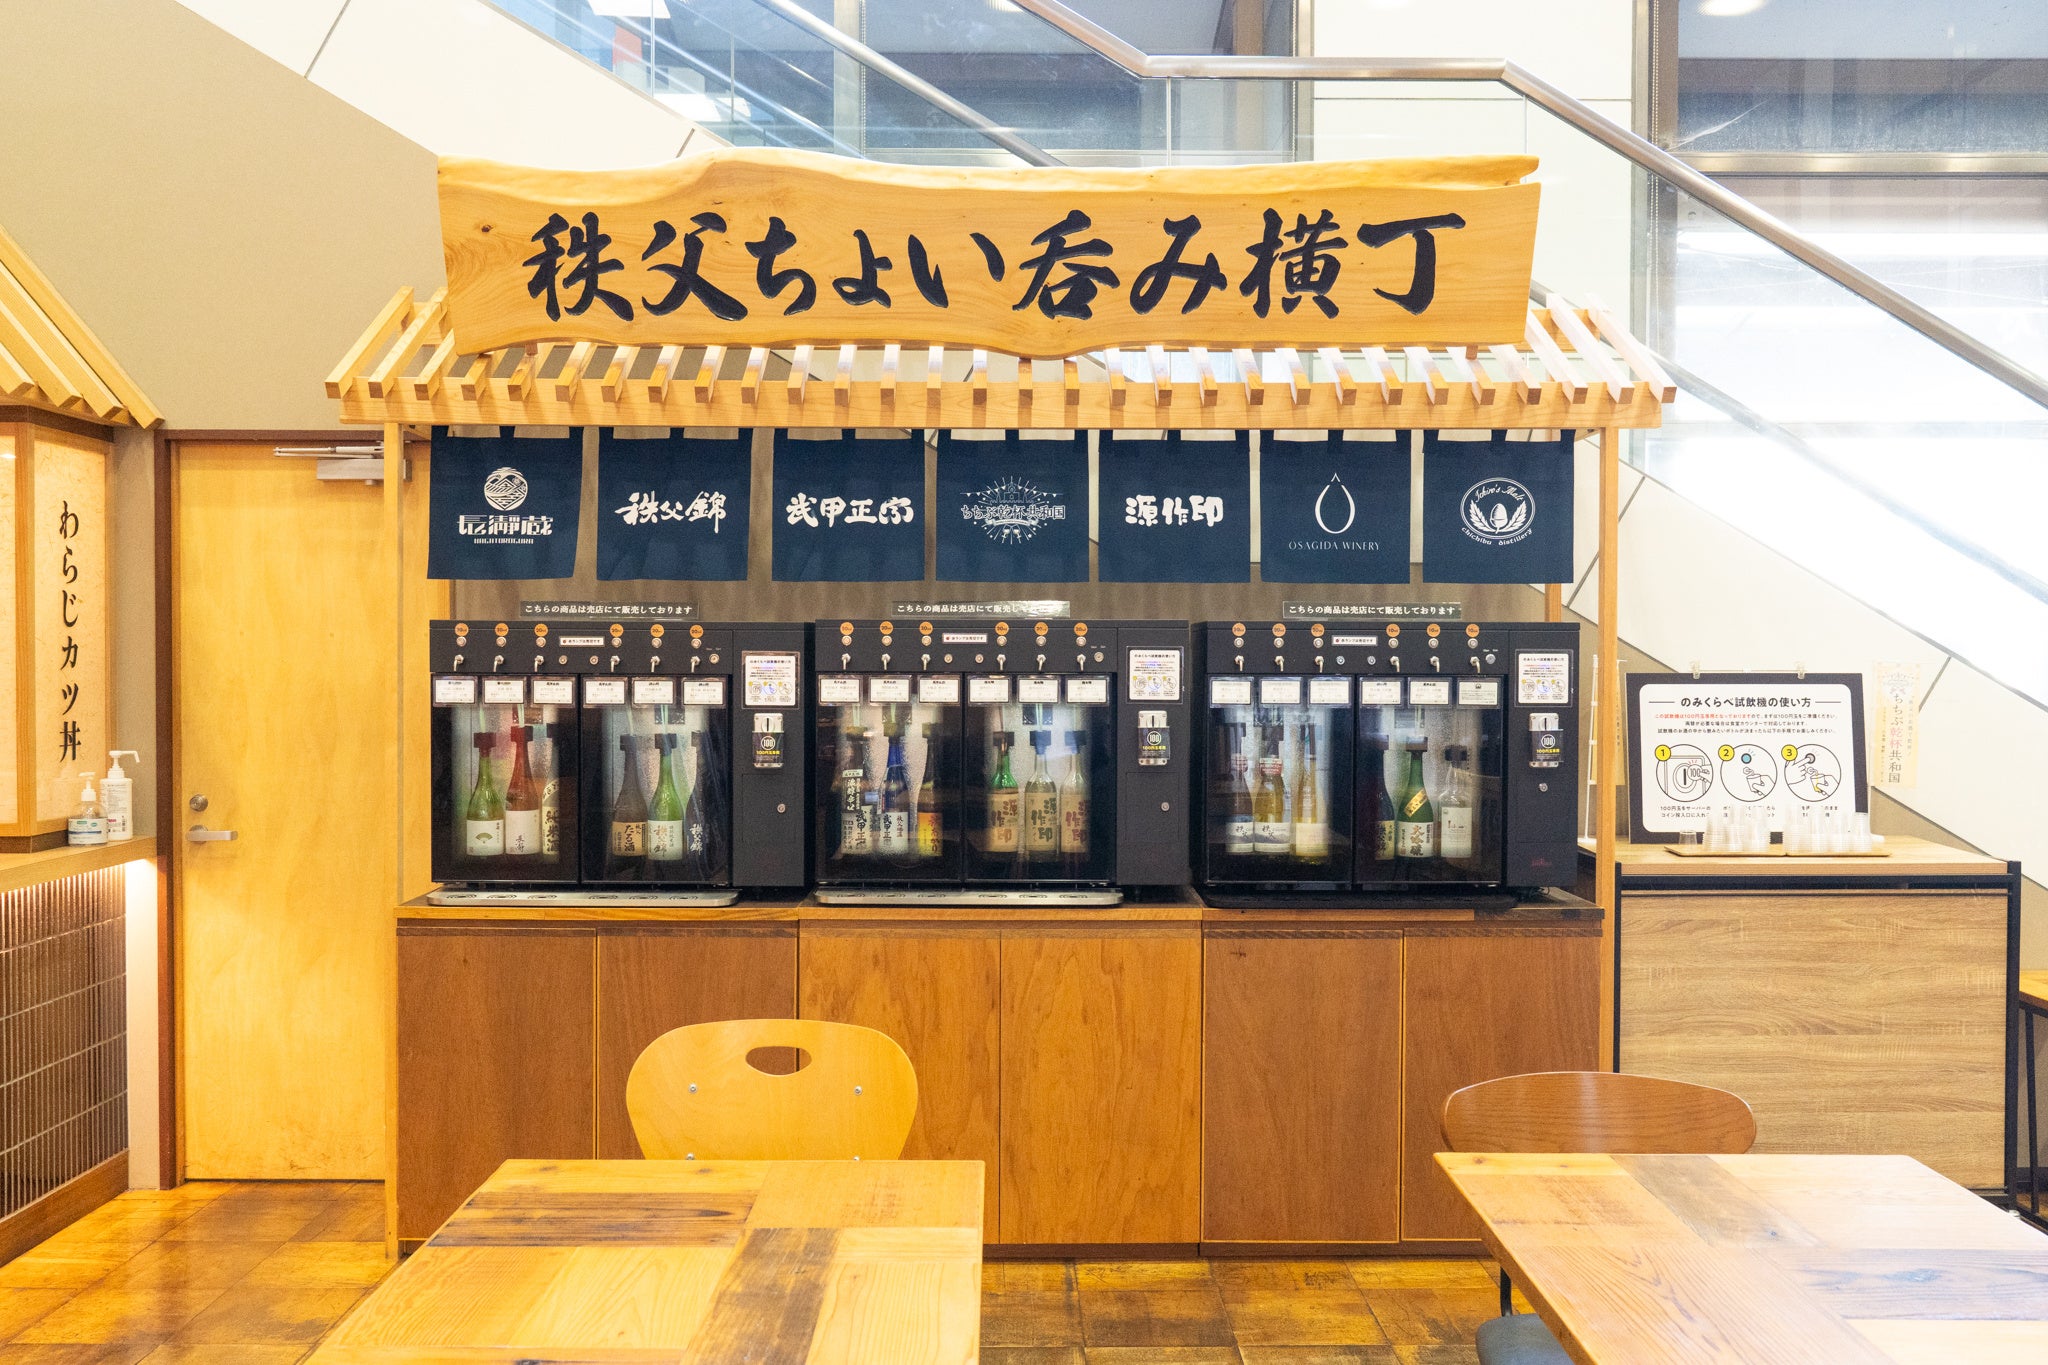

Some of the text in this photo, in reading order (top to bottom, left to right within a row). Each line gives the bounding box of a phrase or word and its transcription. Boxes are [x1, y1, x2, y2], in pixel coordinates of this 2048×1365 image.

[524, 207, 1466, 323] 秩父ちょい呑み横丁
[614, 490, 727, 534] 秩父錦
[785, 492, 915, 528] 武甲正宗
[961, 504, 1066, 520] ちちぶ乾杯共和国
[1125, 494, 1224, 527] 源作印
[1288, 540, 1380, 551] OSAGIDA WINERY
[525, 604, 693, 615] こちらの商品は売店にて販売しております
[1289, 605, 1455, 615] こちらの商品は売店にて販売しております
[59, 500, 82, 764] わらじカツ丼
[1681, 697, 1811, 708] のみくらべ試飲機の使い方
[763, 739, 774, 747] 100
[1149, 734, 1160, 743] 100
[1543, 737, 1554, 746] 100
[1888, 693, 1904, 784] ちちぶ乾杯共和国
[1660, 748, 1666, 757] 1
[1723, 748, 1730, 757] 2
[1786, 748, 1793, 757] 3
